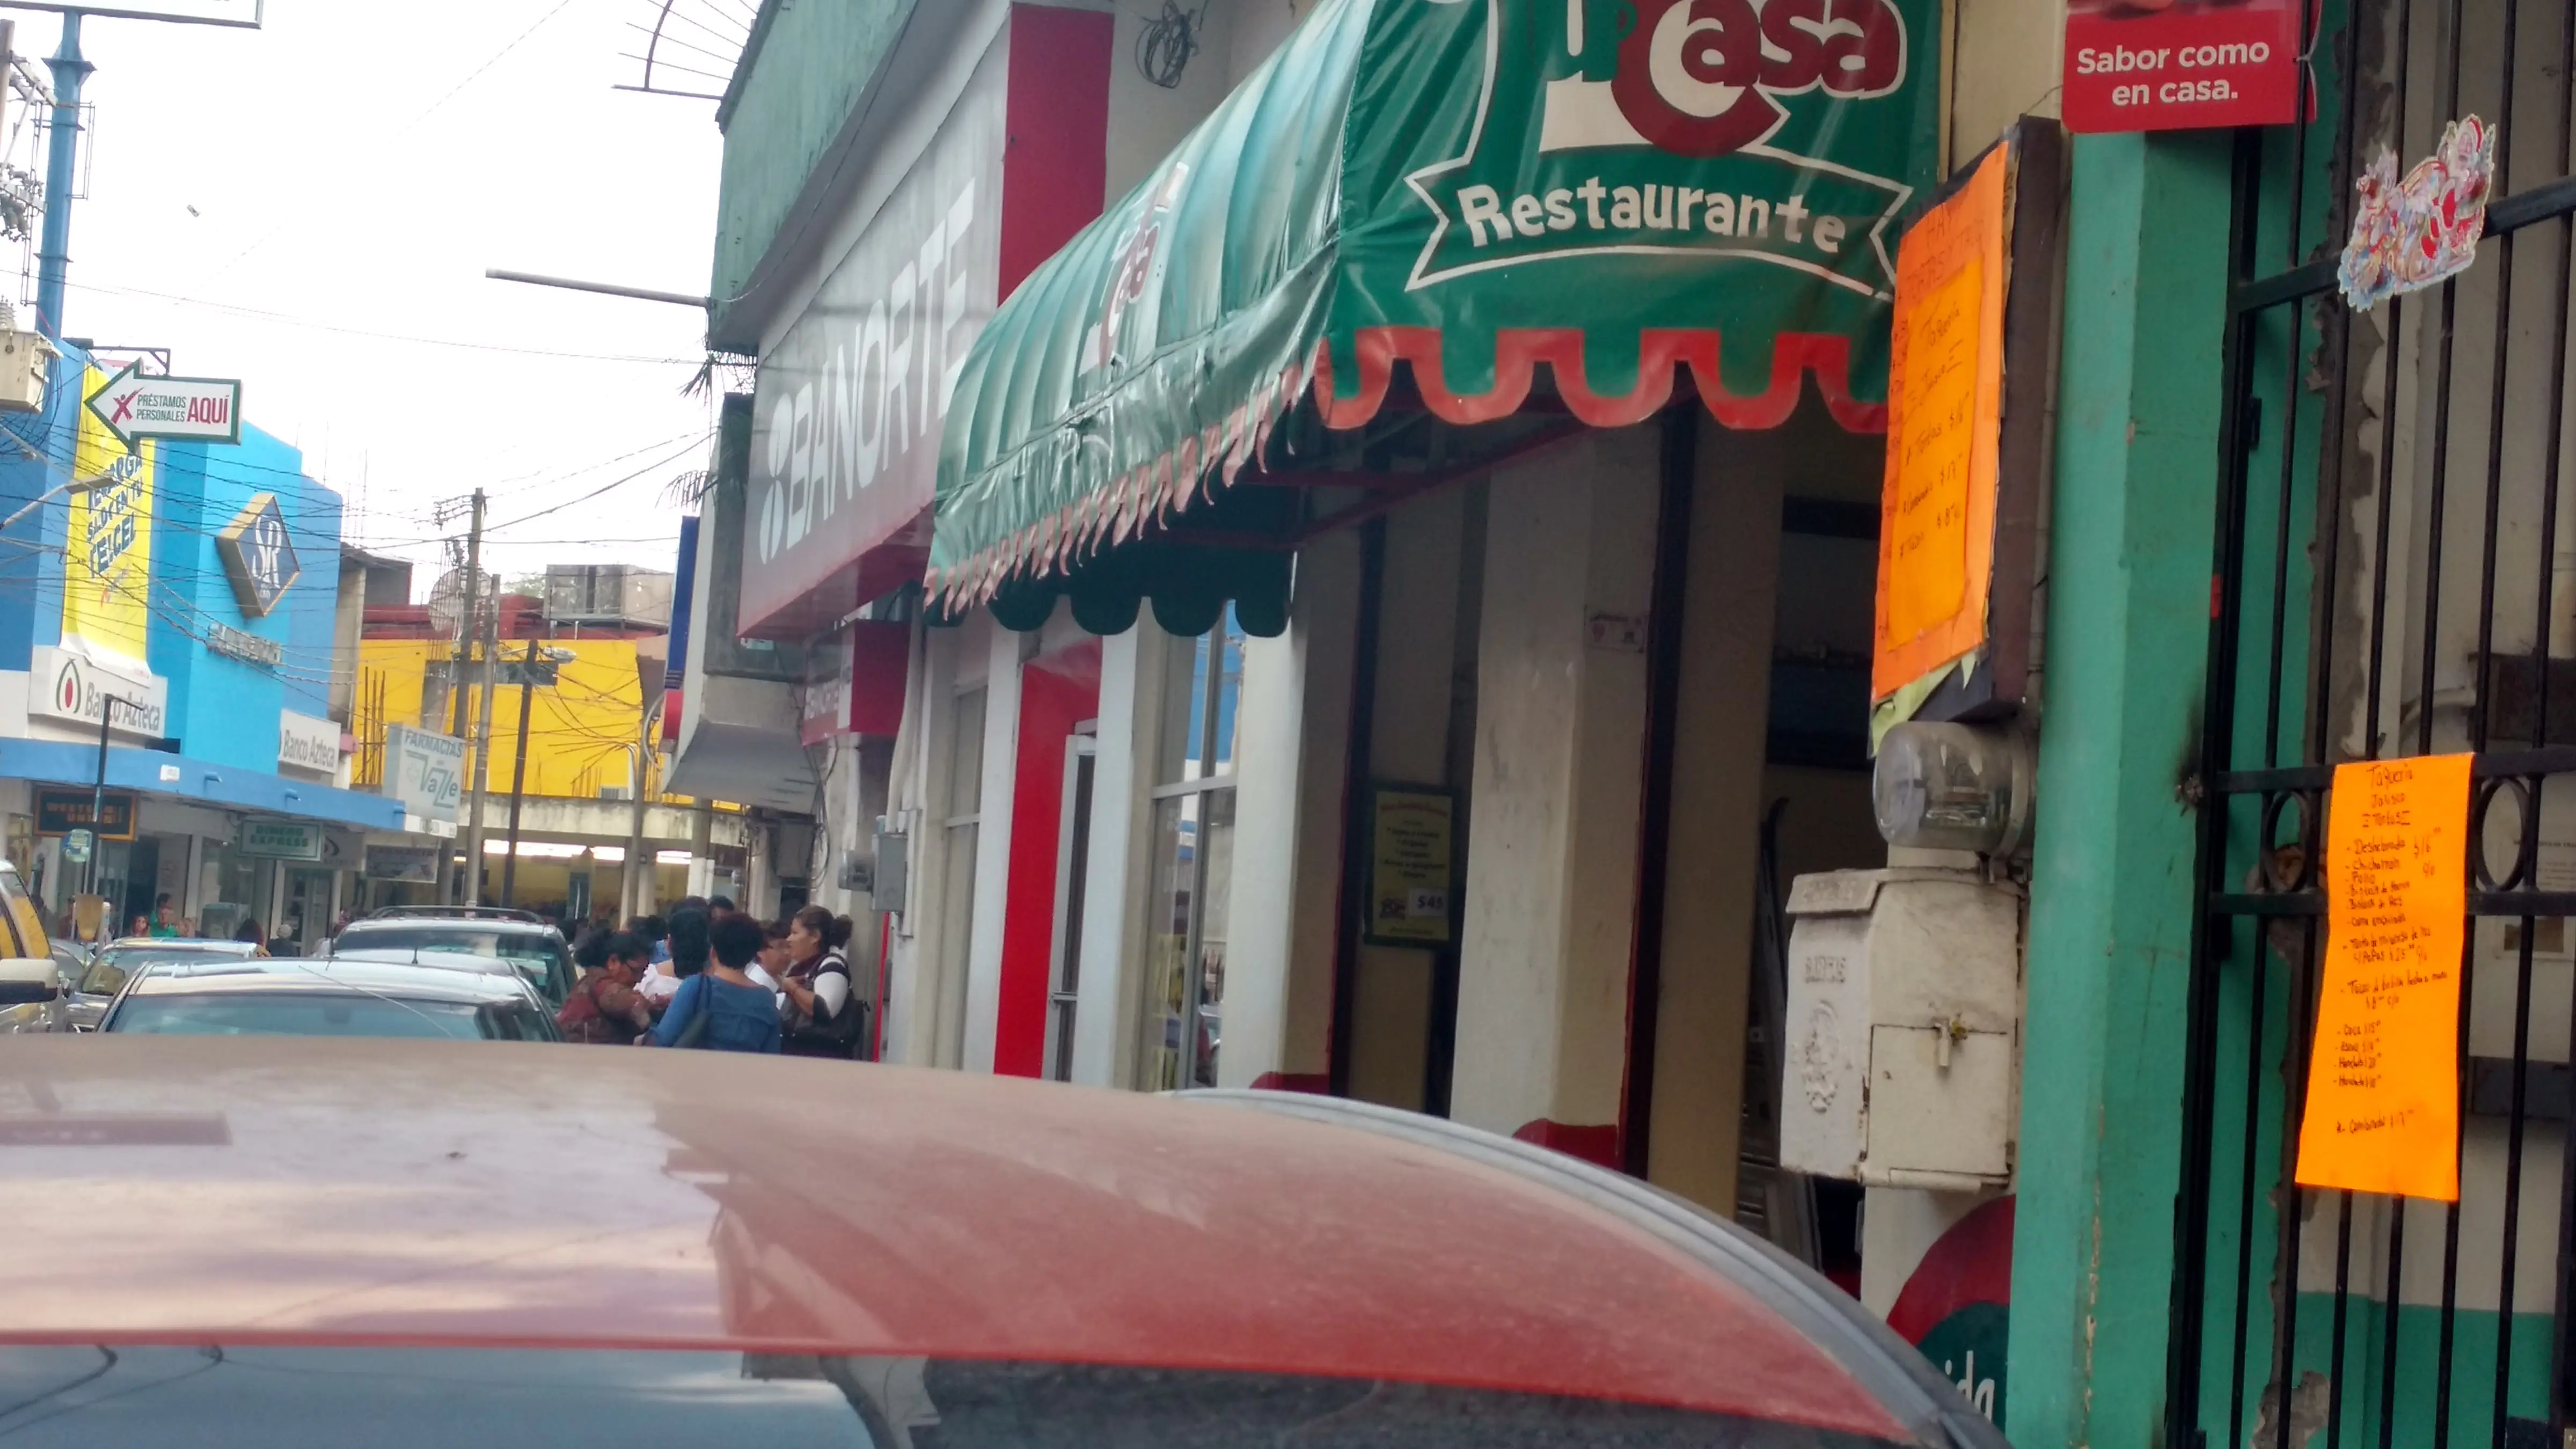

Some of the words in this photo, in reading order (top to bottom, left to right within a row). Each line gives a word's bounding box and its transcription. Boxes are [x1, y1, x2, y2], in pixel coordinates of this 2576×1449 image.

[2077, 45, 2170, 74] Sabor
[2178, 41, 2270, 68] como
[2112, 84, 2149, 106] en
[2160, 78, 2238, 103] casa.
[1458, 177, 1846, 252] Restaurante
[787, 177, 975, 550] BANORTE
[136, 409, 185, 422] PERSONALES
[187, 394, 230, 424] AQUÍ
[90, 511, 135, 579] TELCEL
[85, 682, 121, 723] Bao
[405, 730, 462, 758] FARMACIAS
